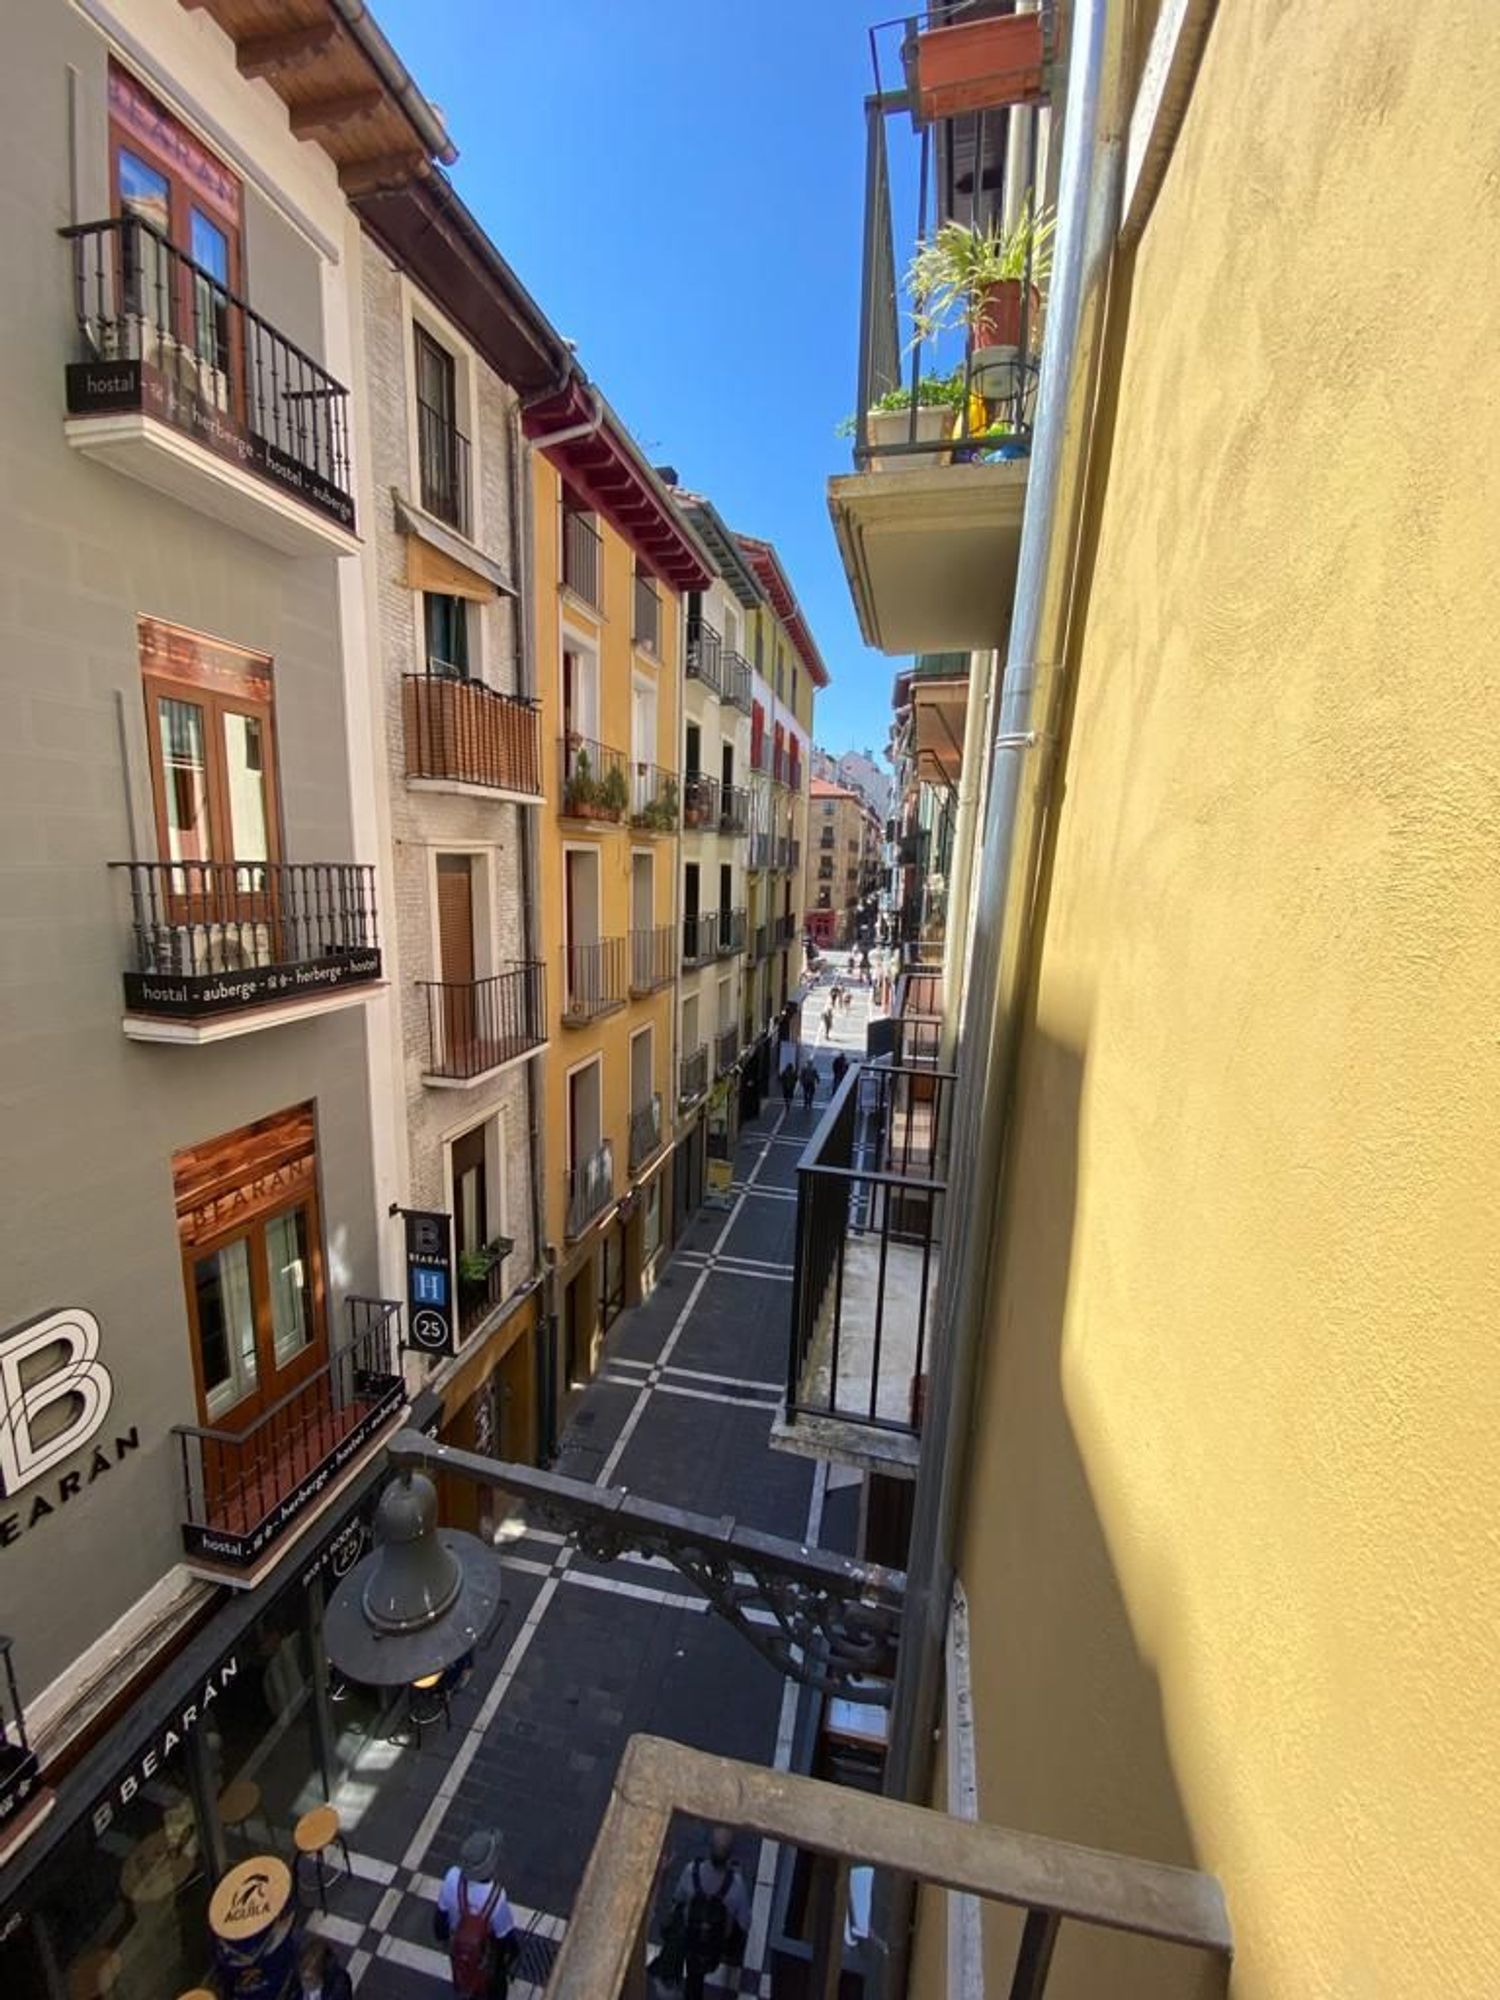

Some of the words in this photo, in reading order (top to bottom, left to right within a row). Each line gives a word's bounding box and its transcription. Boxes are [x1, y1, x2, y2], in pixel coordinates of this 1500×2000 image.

[87, 373, 134, 393] hostal
[266, 444, 302, 487] hostel
[143, 982, 187, 1001] hostal
[203, 981, 256, 1001] auberge
[296, 964, 342, 983] herberge
[419, 1273, 440, 1300] H
[421, 1320, 440, 1337] 25
[0, 1307, 112, 1497] B
[202, 1534, 242, 1556] hostal
[120, 1657, 237, 1804] BEARÁN
